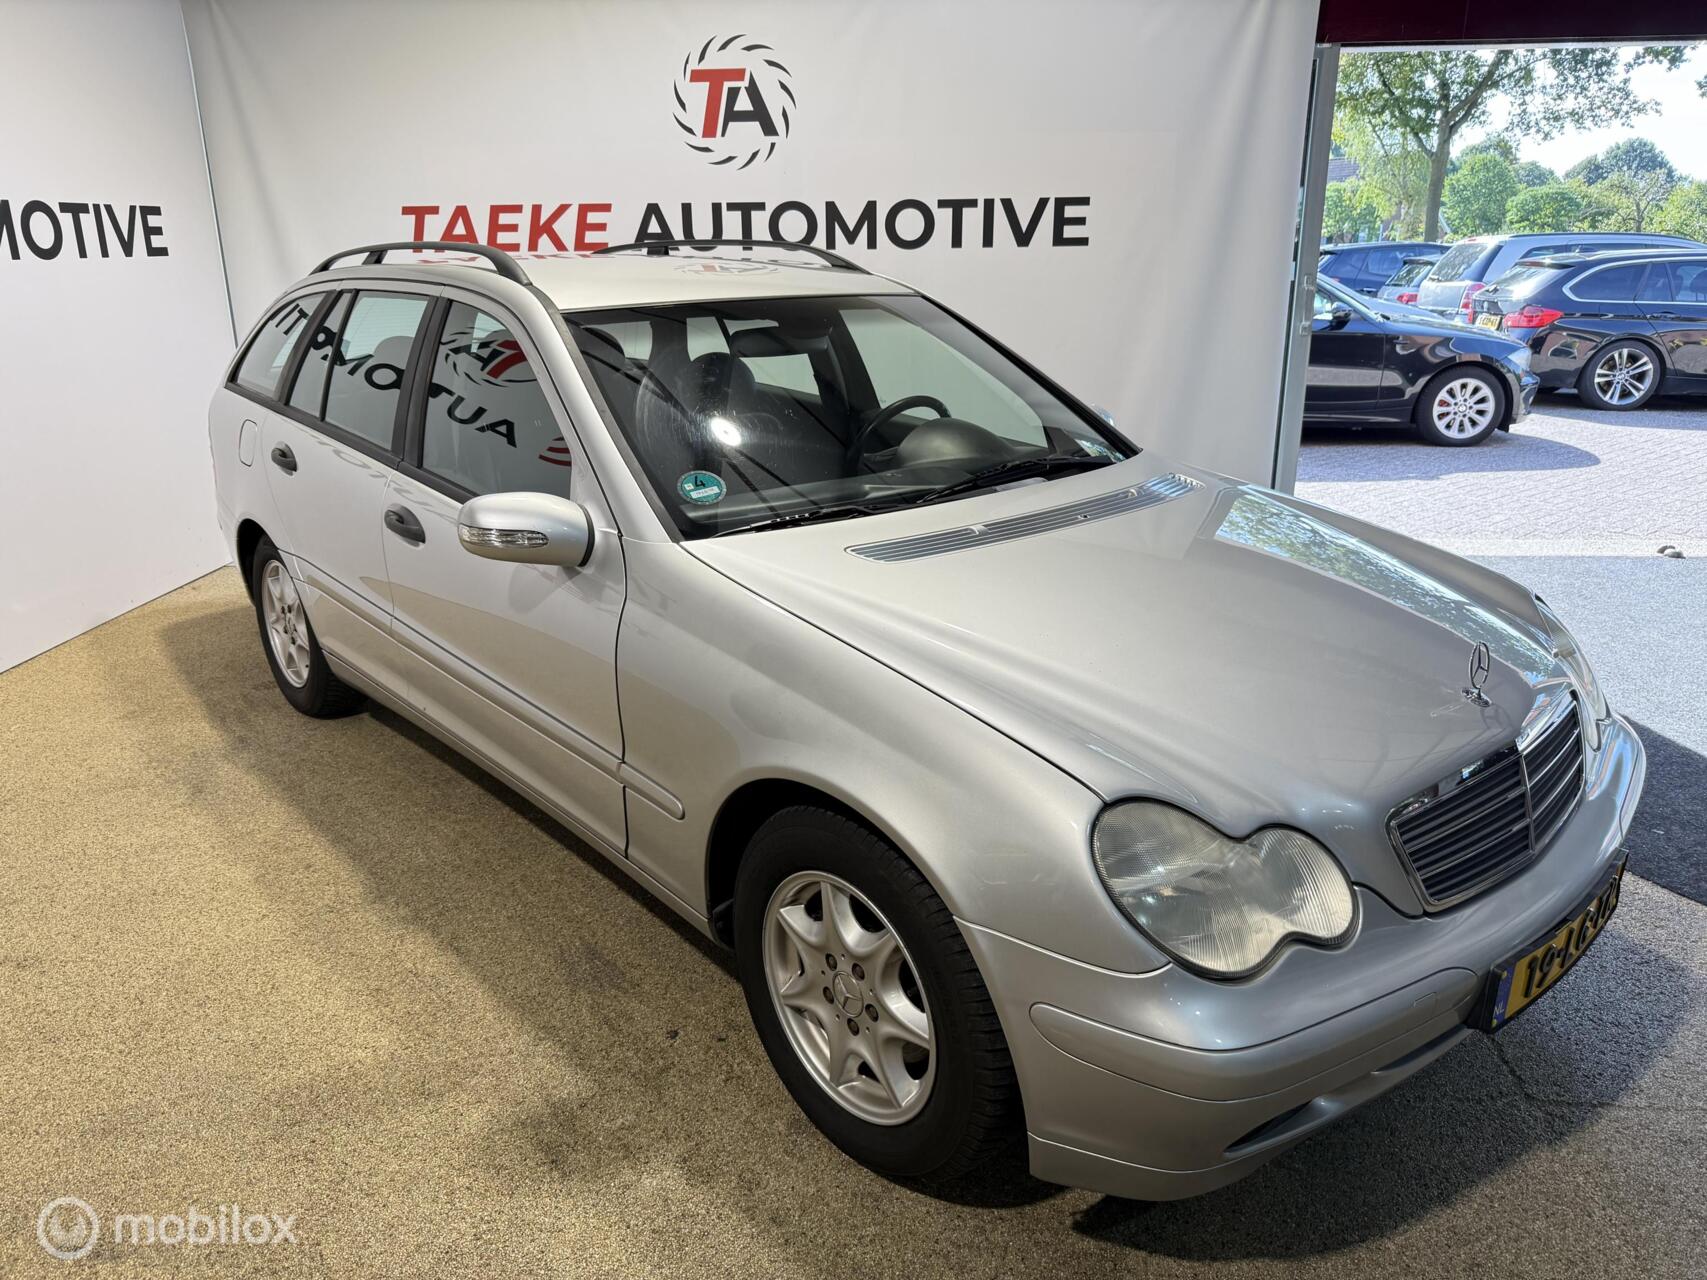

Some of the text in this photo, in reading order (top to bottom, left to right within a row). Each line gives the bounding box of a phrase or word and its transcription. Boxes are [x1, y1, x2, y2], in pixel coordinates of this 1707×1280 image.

[690, 68, 779, 138] TA
[401, 196, 1091, 253] TAEKE AUTOMOTIVE
[1493, 1003, 1506, 1016] NL
